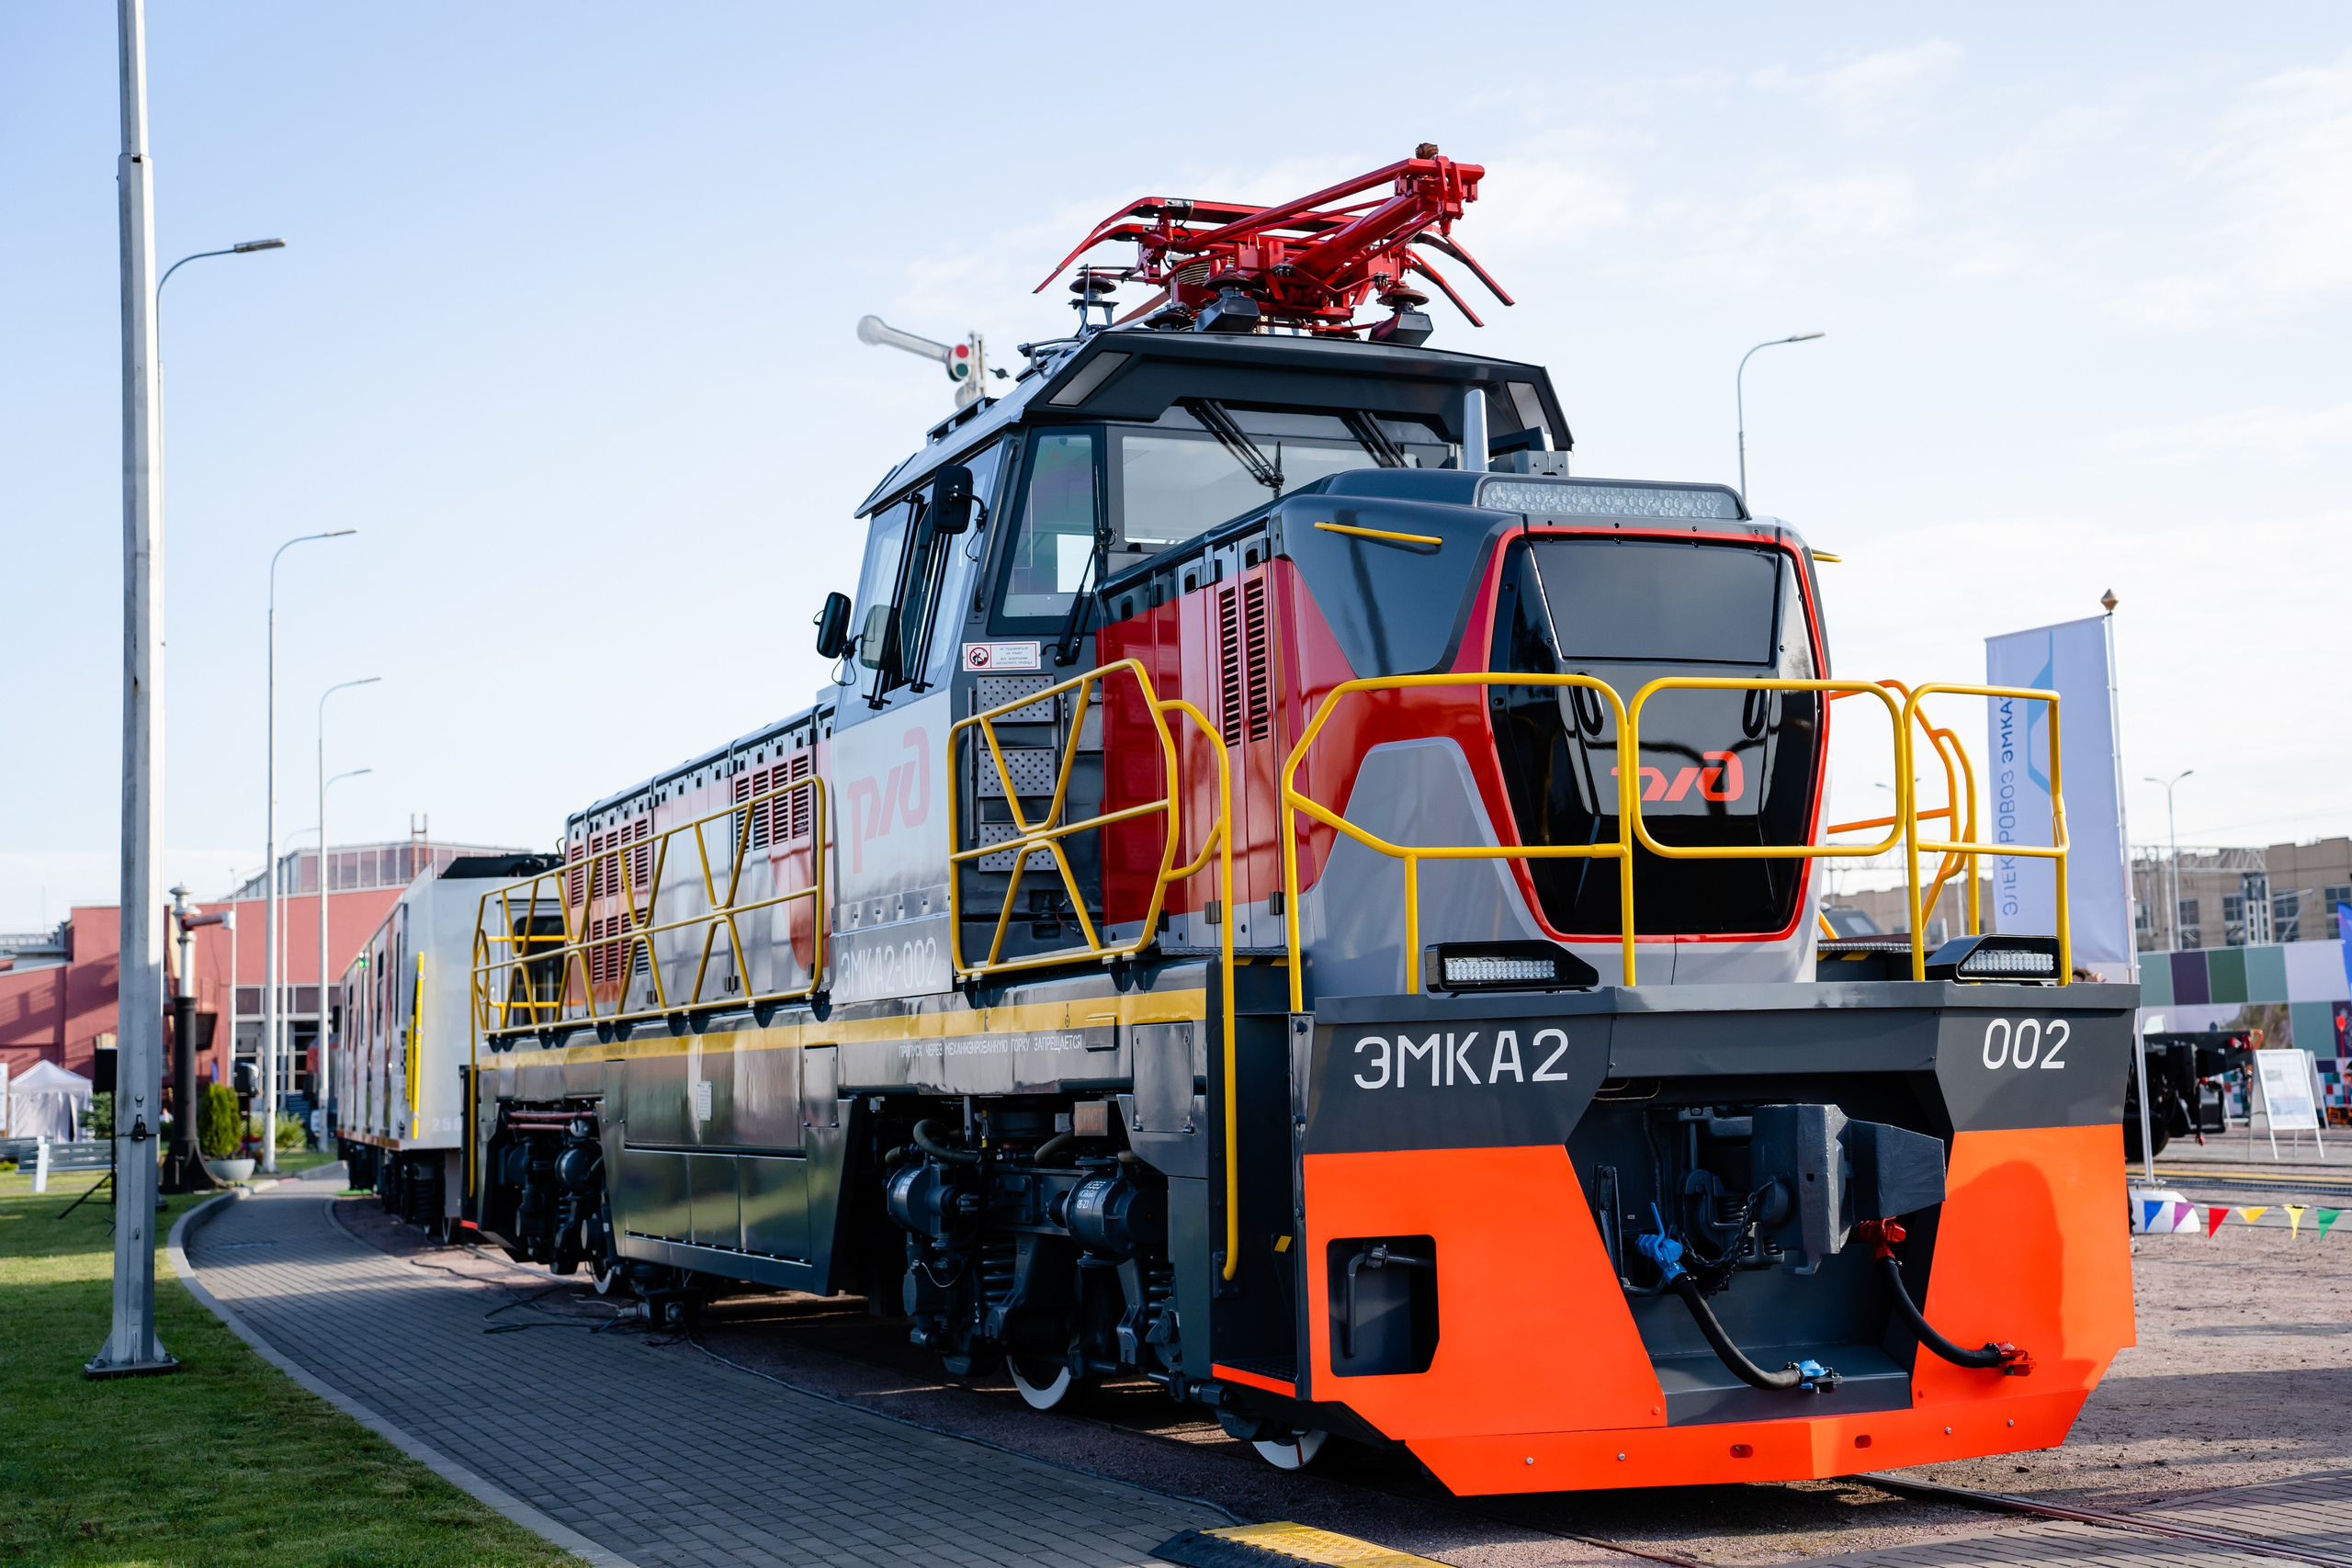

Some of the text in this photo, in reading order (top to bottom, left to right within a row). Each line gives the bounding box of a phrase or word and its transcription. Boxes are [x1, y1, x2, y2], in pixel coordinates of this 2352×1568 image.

[1998, 770, 2018, 916] ЭЛЕКРОВОЗ
[841, 936, 937, 998] ЭМКА2-002
[899, 1034, 1082, 1058] ПРОПУСК ЧЕРЕЗ МЕХАНИЗИРОВАННУЮ ГОРКУ ЗАПРЕЩАЕТСЯ
[1353, 1028, 1569, 1089] ЭМКА2
[1982, 1018, 2071, 1070] 002
